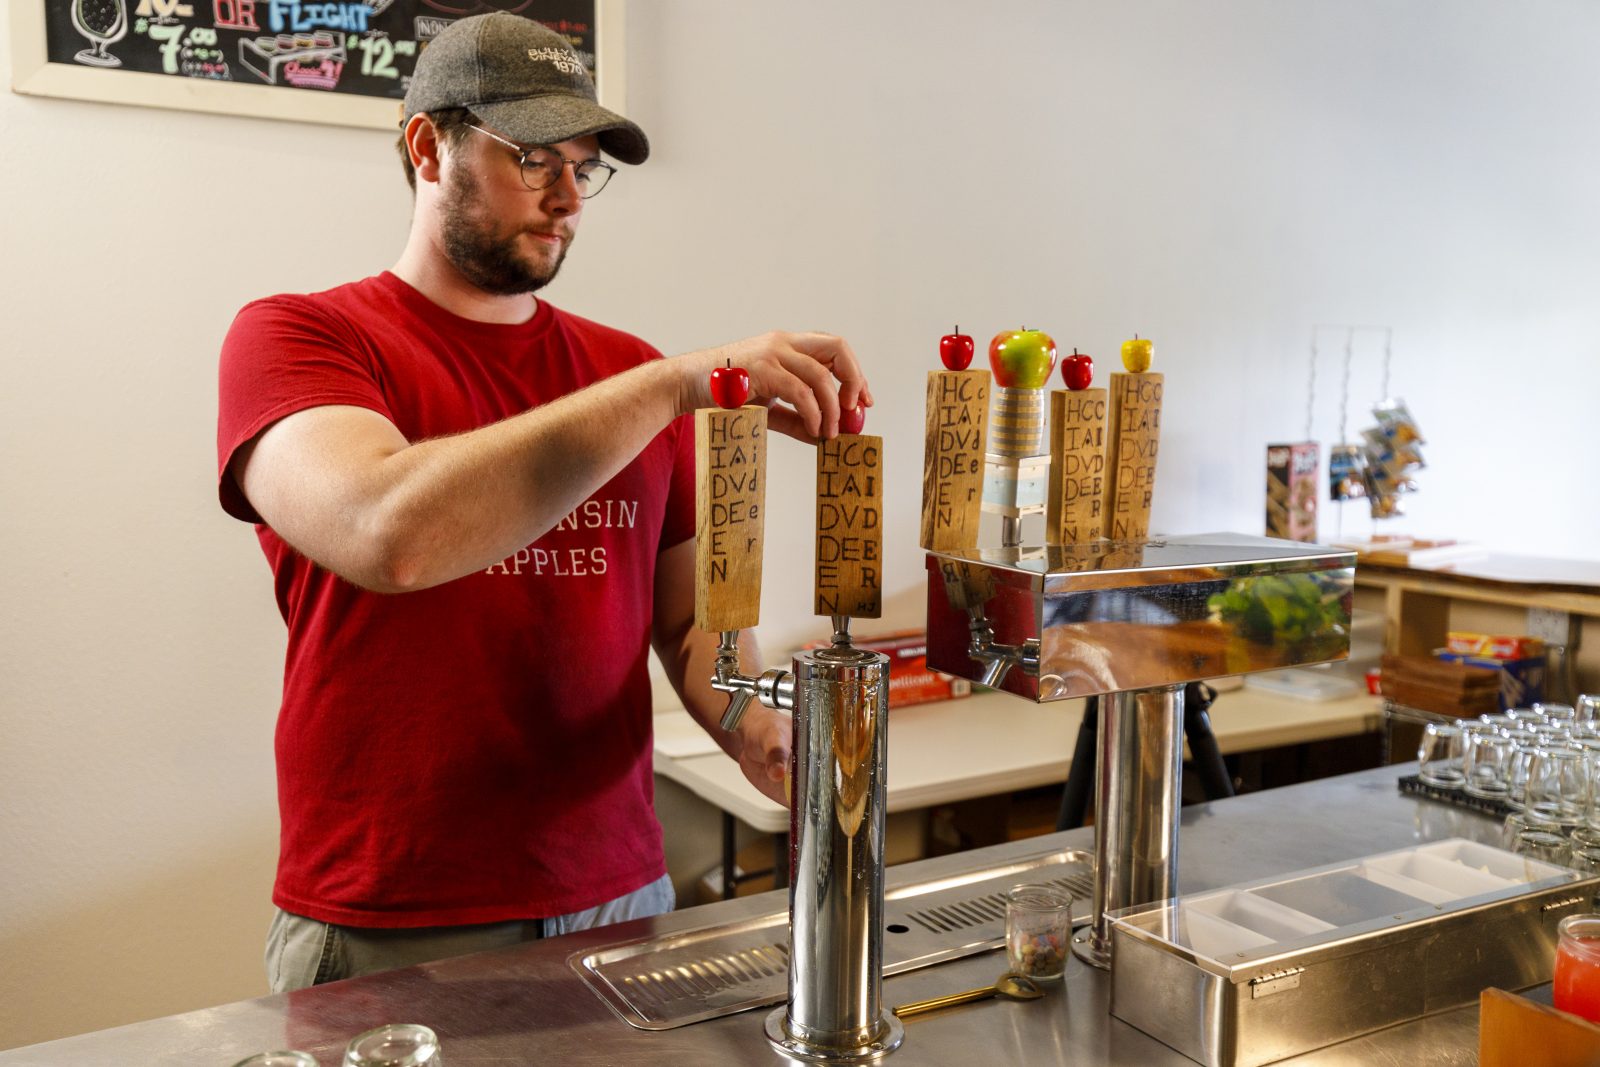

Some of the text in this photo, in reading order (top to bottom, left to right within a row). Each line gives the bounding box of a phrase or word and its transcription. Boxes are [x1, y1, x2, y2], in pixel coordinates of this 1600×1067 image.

[214, 0, 260, 29] OR
[268, 0, 374, 32] FLIGHT
[528, 47, 569, 56] BULLY
[552, 61, 583, 75] 1970
[729, 416, 746, 525] CAVE
[938, 376, 957, 528] HIDDEN
[953, 377, 972, 475] CAVE
[1063, 400, 1081, 543] HIDDEN
[1080, 400, 1094, 498] CAVE
[1091, 400, 1104, 519] CIDER
[1113, 379, 1138, 539] HIDDEN
[1133, 382, 1152, 488] CAVE
[1142, 382, 1162, 508] CIDER
[711, 417, 727, 584] HIDDEN
[818, 440, 840, 614] HIDDEN
[841, 443, 861, 562] CAVE
[861, 447, 878, 589] CIDER
